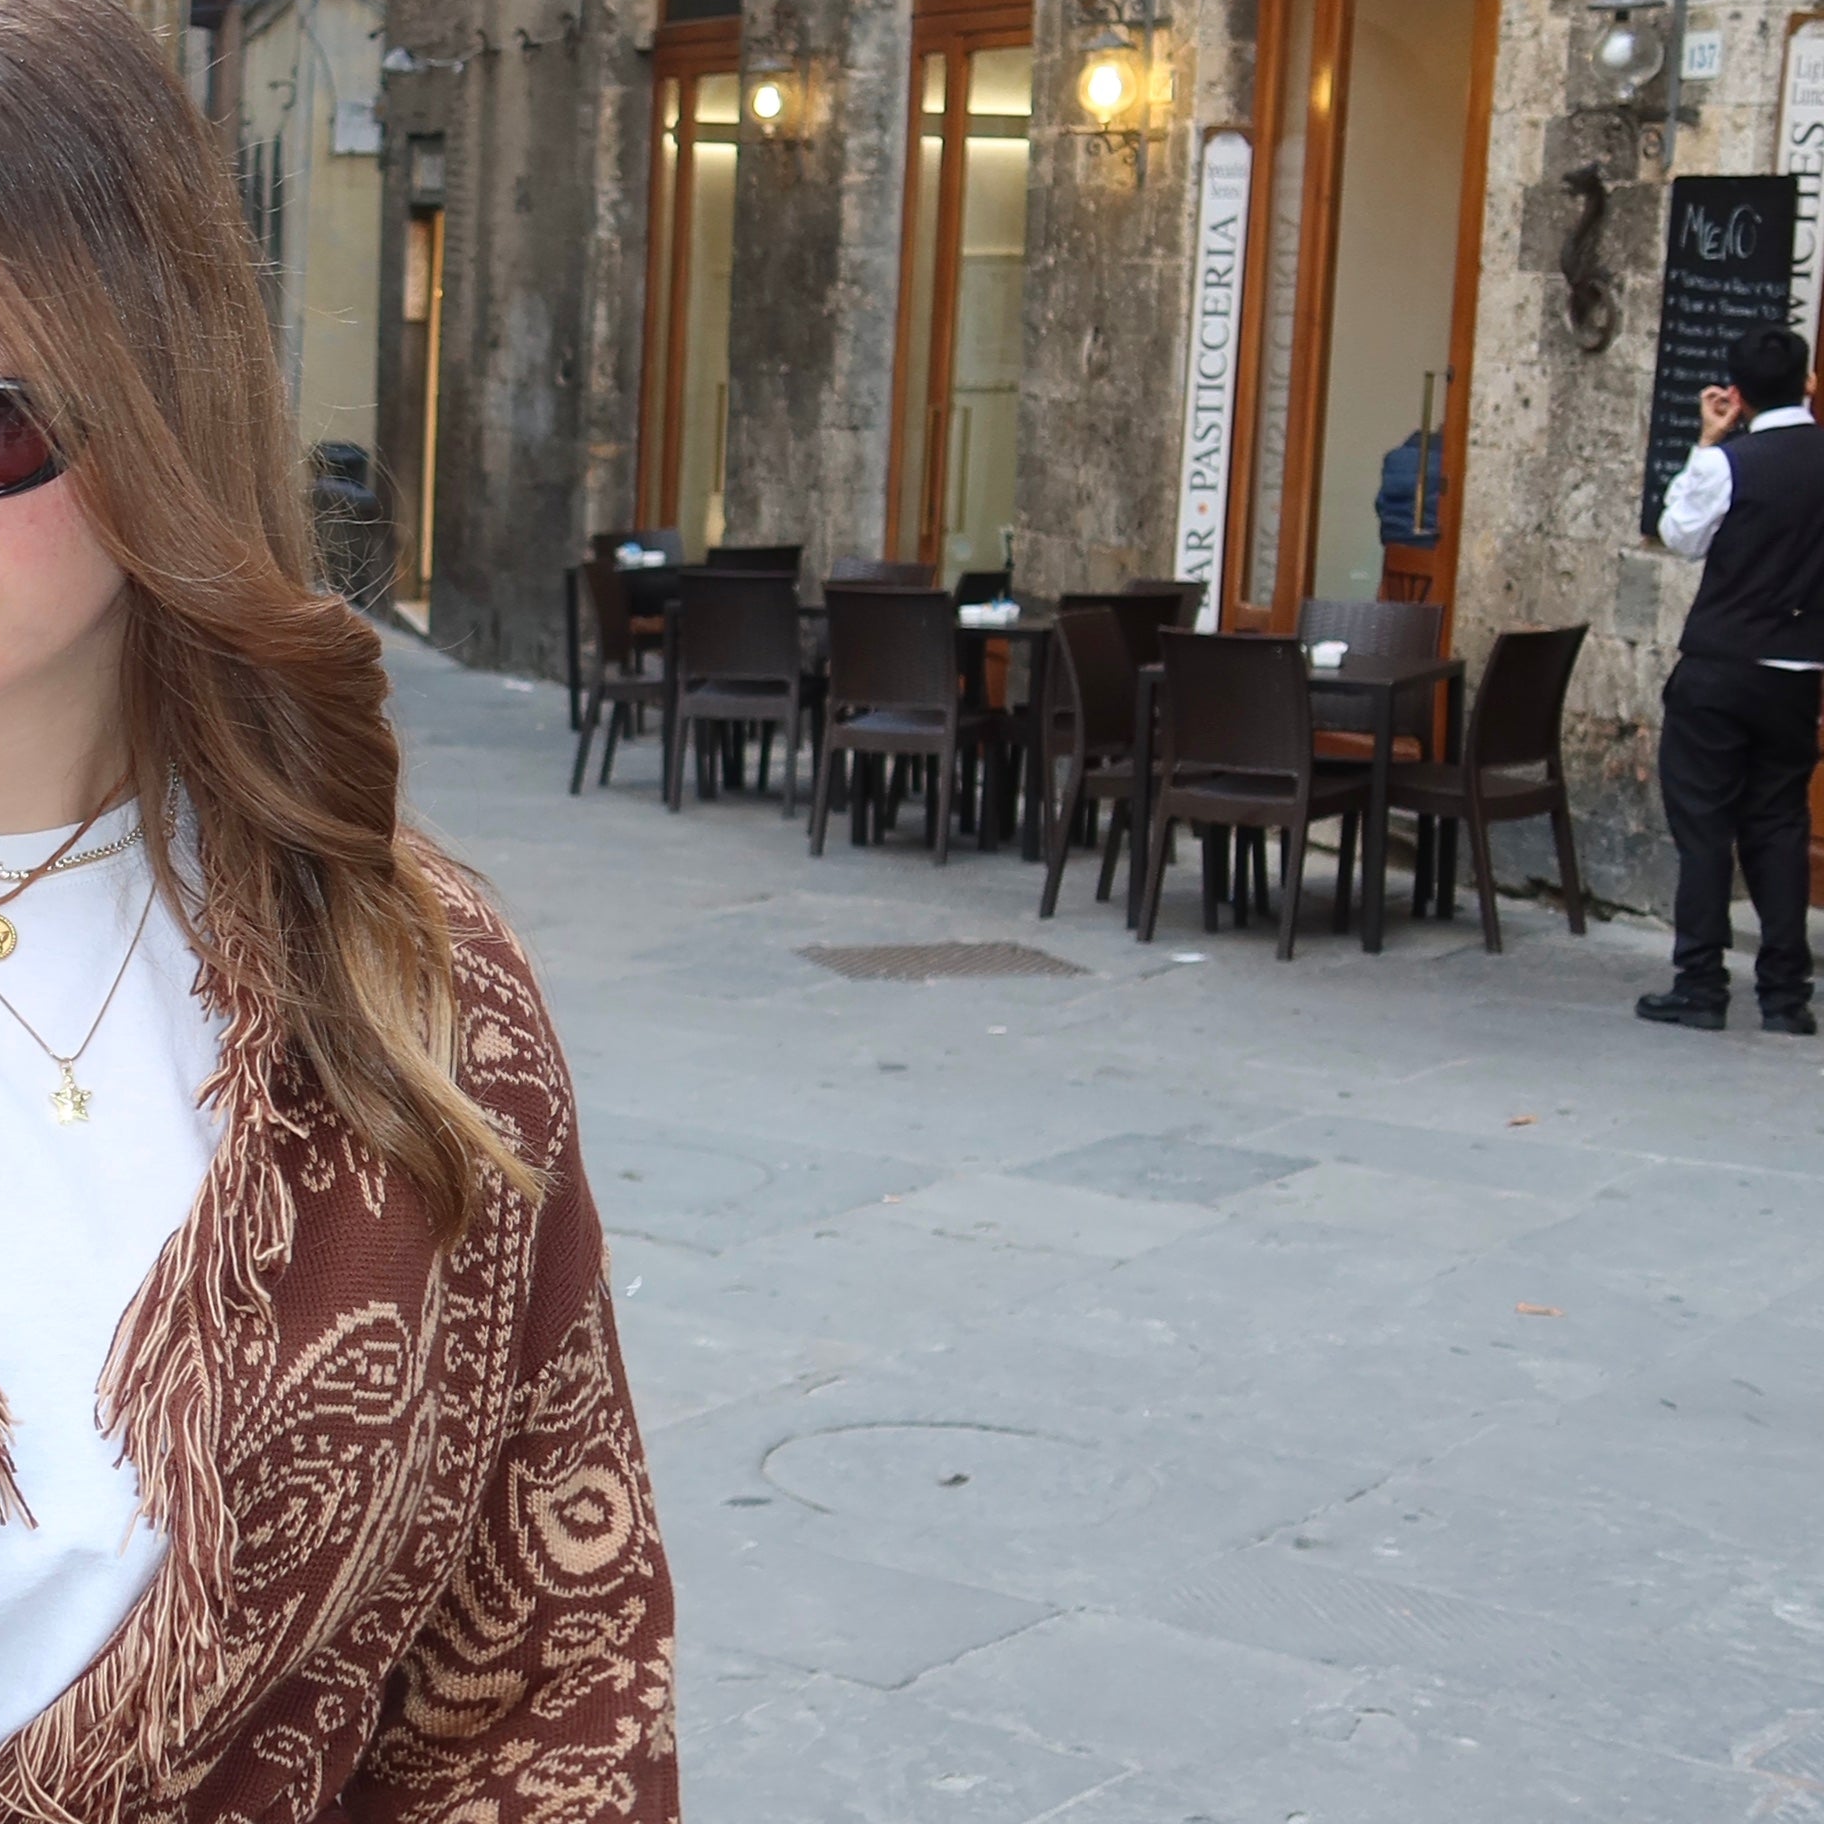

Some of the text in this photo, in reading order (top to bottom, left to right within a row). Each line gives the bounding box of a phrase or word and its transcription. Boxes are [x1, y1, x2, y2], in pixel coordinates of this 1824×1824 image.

[1688, 43, 1717, 71] 137
[1796, 55, 1824, 84] Lig
[1190, 213, 1239, 494] PASTICCERIA
